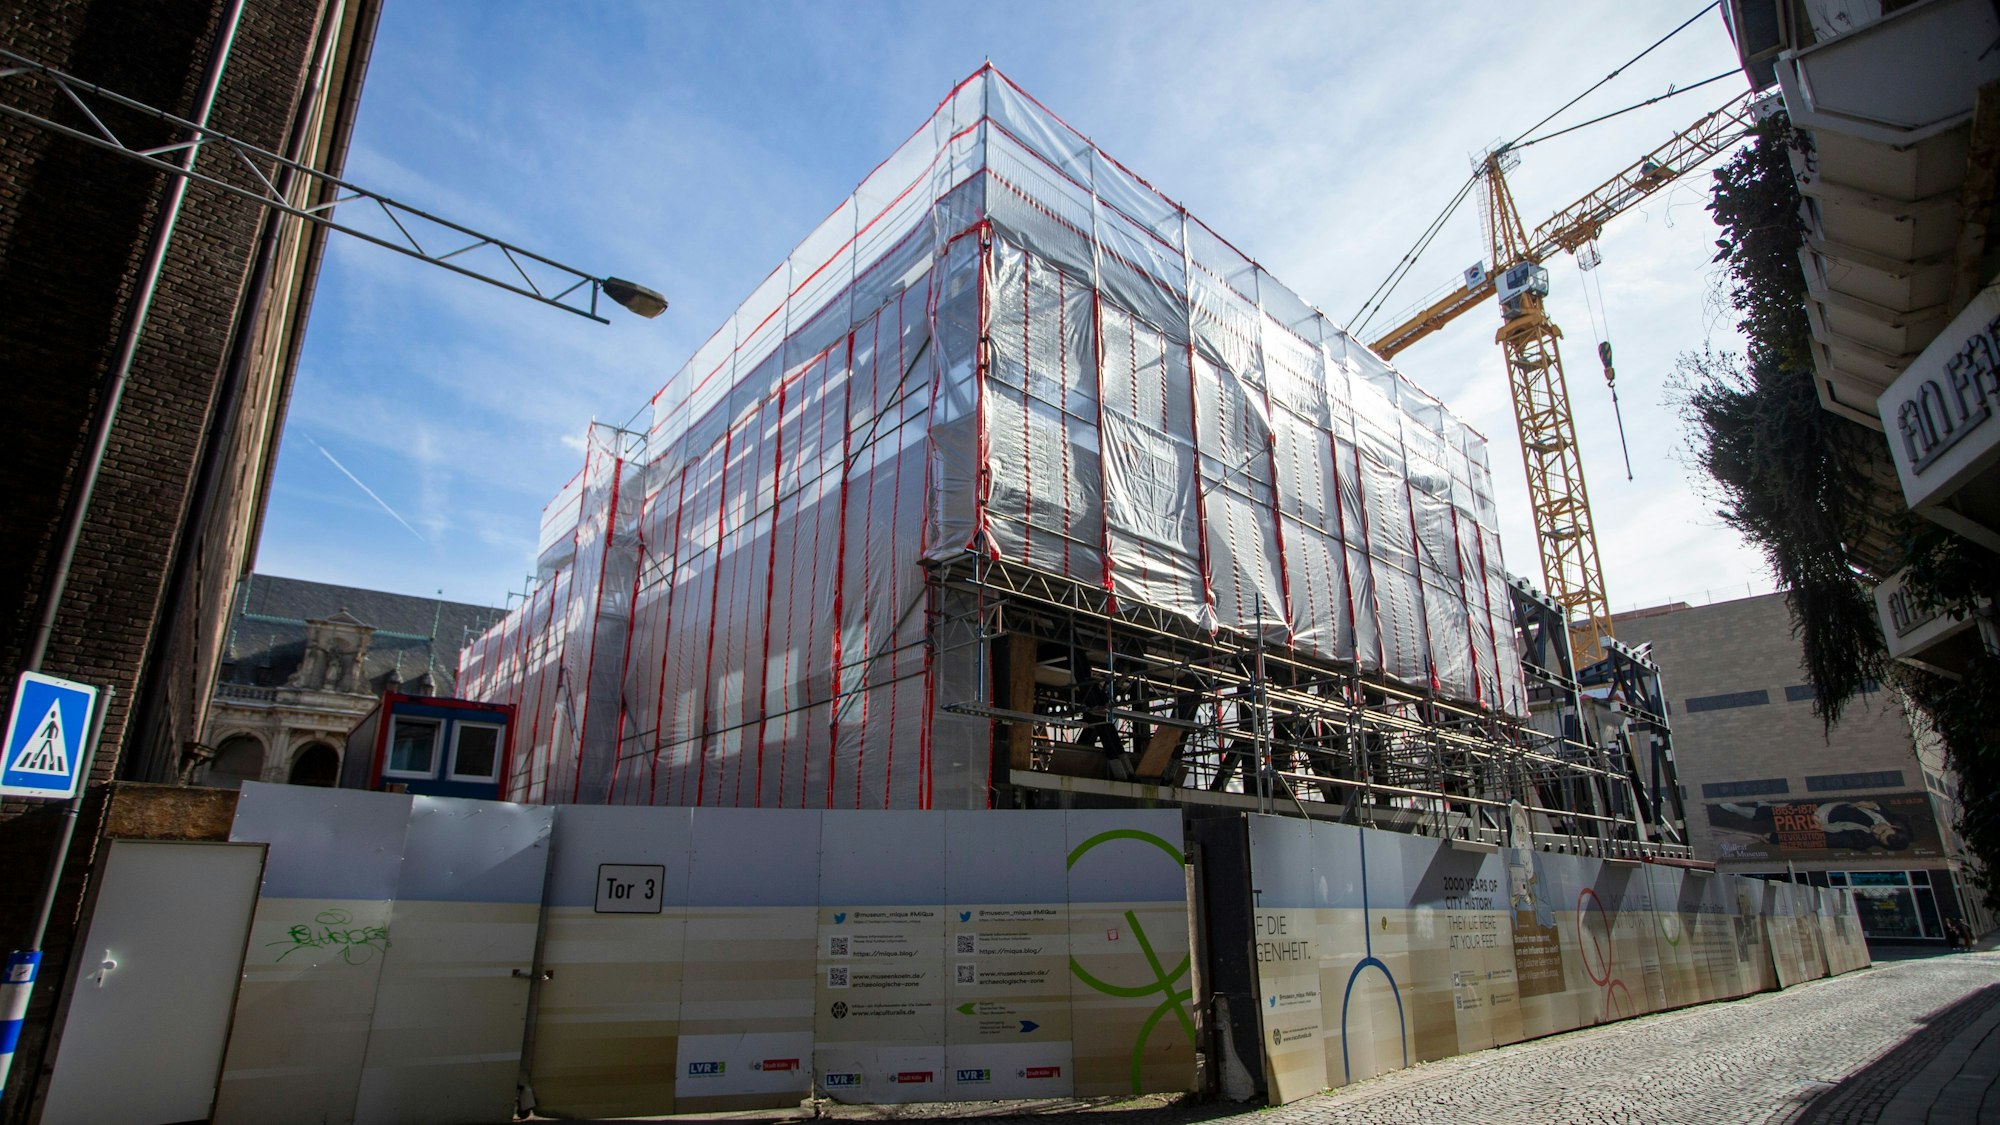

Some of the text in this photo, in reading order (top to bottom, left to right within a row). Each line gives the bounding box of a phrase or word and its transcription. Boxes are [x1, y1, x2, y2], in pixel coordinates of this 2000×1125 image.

[1720, 842, 1747, 851] Wallraf
[1736, 850, 1768, 859] Museum
[607, 878, 655, 900] Tor 3
[1444, 876, 1498, 893] 2000 YEARS OF
[1446, 896, 1495, 911] CITY HISTORY.
[854, 911, 908, 919] @museum_miqua
[979, 909, 1031, 917] @museum_miqua
[1267, 916, 1287, 935] DIE
[1447, 915, 1497, 930] THEY LIE HERE
[1450, 935, 1459, 950] AT
[1461, 934, 1481, 949] YOUR
[853, 950, 918, 958] https://miqua.blog/
[979, 947, 1042, 956] https://miqua.blog/
[1257, 942, 1310, 962] GENHEIT.
[852, 981, 919, 989] archaeologische-zone
[979, 978, 1044, 987] archaeologische-zone
[852, 1008, 916, 1017] www.viaculturalis.de
[690, 1063, 713, 1074] LVR
[828, 1075, 849, 1085] LVR
[958, 1070, 978, 1080] LVR
